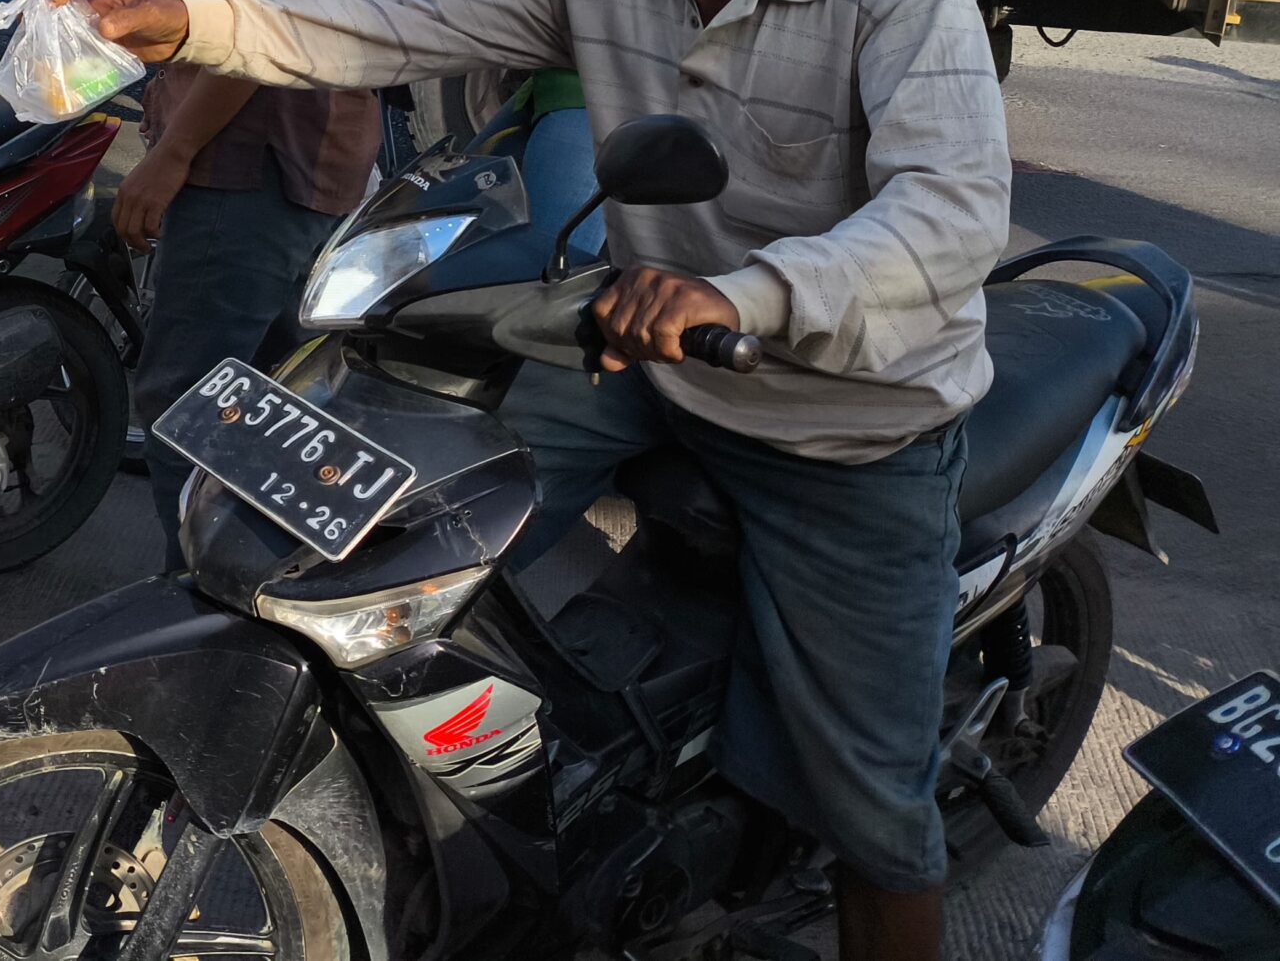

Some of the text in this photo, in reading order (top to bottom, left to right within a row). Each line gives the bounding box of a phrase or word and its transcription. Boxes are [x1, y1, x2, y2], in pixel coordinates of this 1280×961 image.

[199, 366, 395, 500] BG 5776 TJ
[426, 726, 504, 758] HONDA
